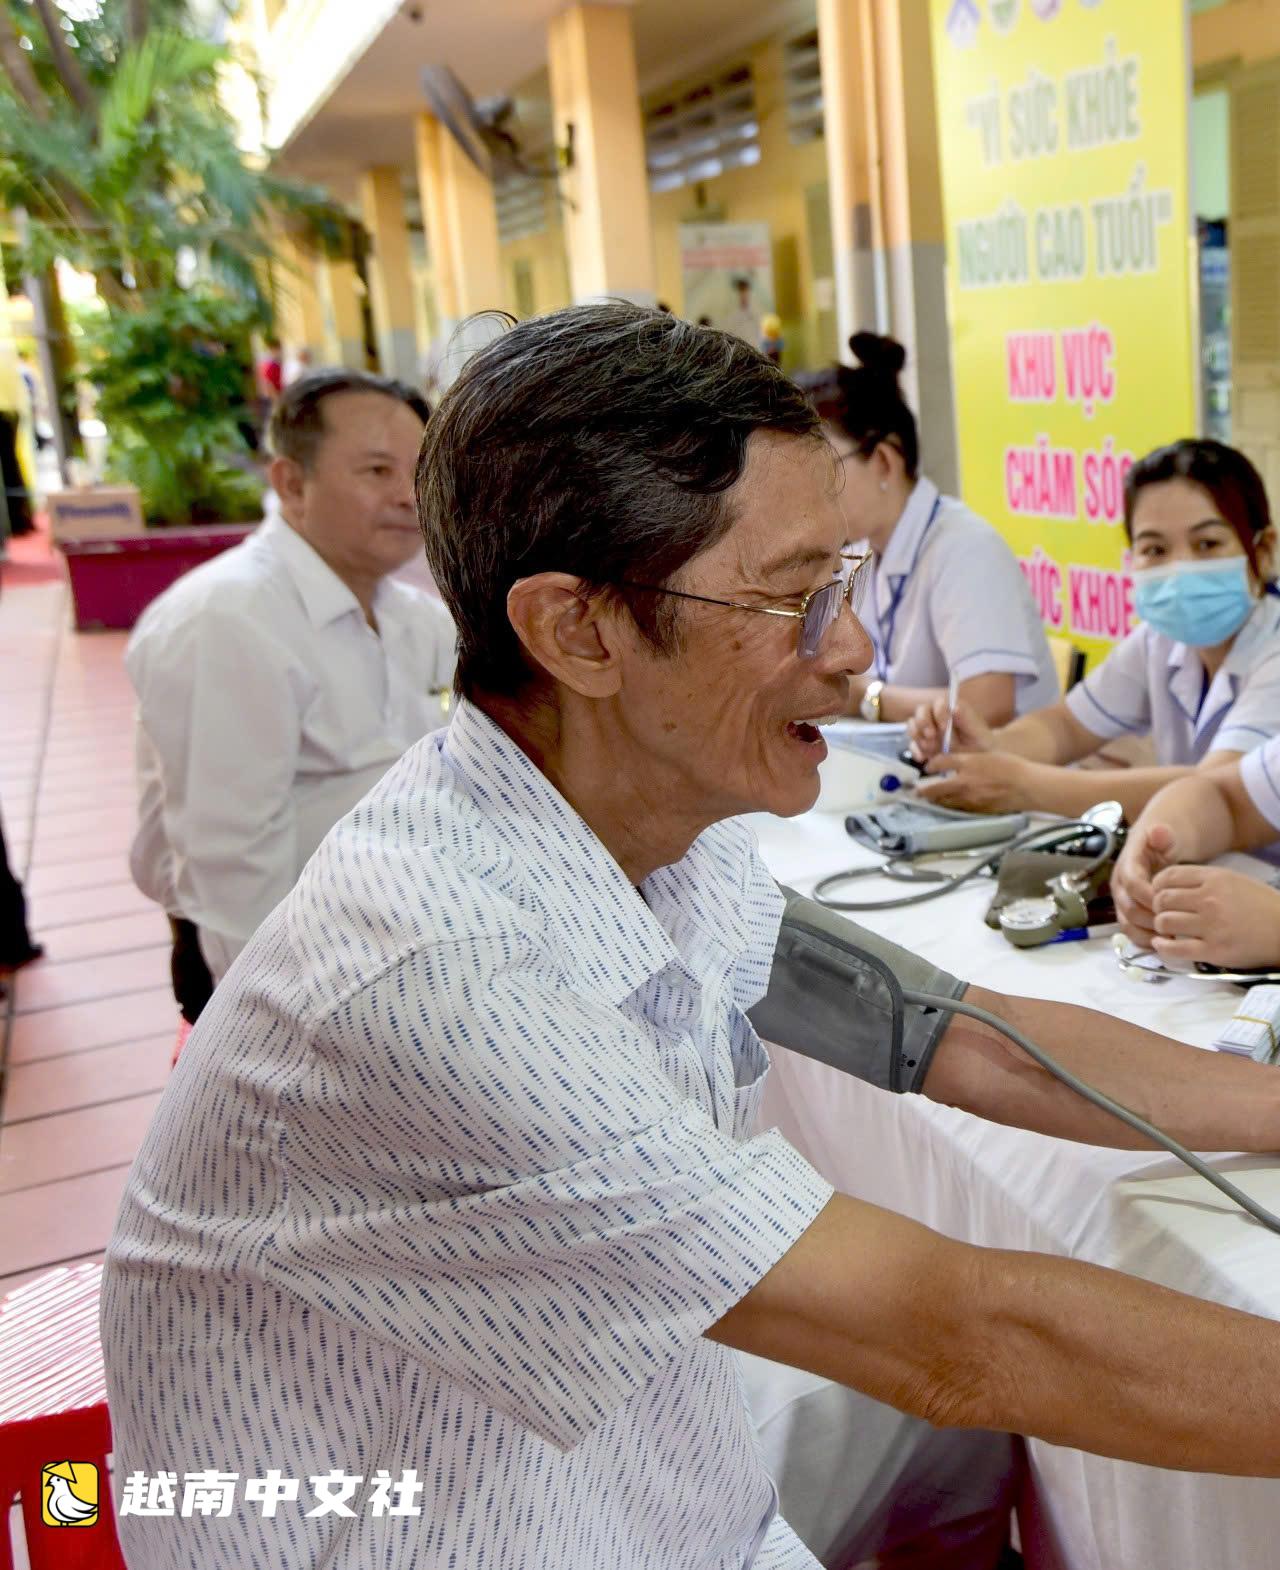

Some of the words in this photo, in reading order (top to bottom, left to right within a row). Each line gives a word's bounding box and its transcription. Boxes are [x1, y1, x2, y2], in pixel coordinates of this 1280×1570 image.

[1036, 206, 1085, 281] CAO
[1007, 334, 1055, 400] KHU
[1062, 323, 1113, 416] VỰC
[1007, 437, 1077, 517] CHĂM
[1084, 439, 1133, 519] SÓ
